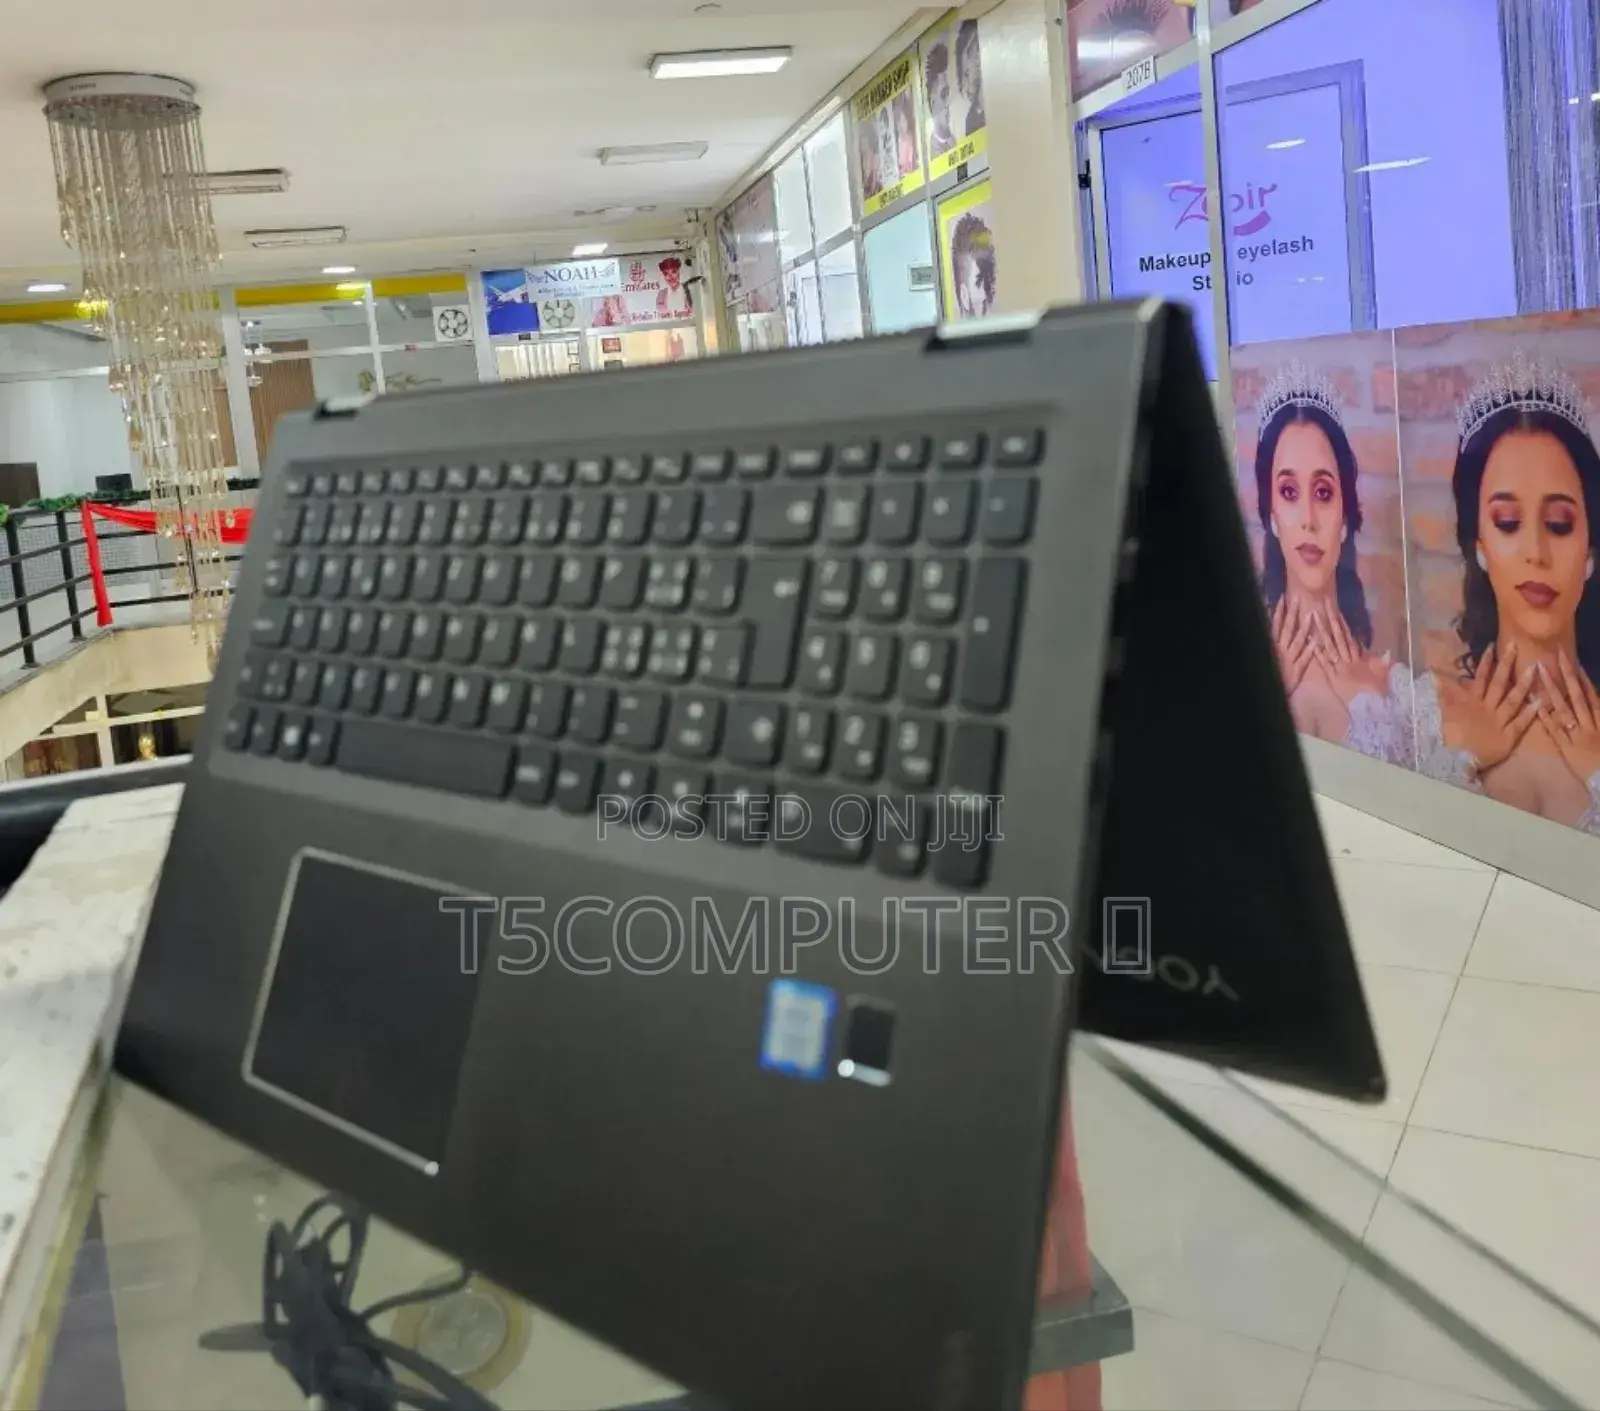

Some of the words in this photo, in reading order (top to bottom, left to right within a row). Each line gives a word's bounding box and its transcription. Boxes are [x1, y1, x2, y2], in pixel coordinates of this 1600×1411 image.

[1139, 251, 1212, 273] Makeup
[1237, 235, 1315, 262] eyelash
[544, 266, 597, 283] NOAH
[1192, 270, 1254, 291] Stio
